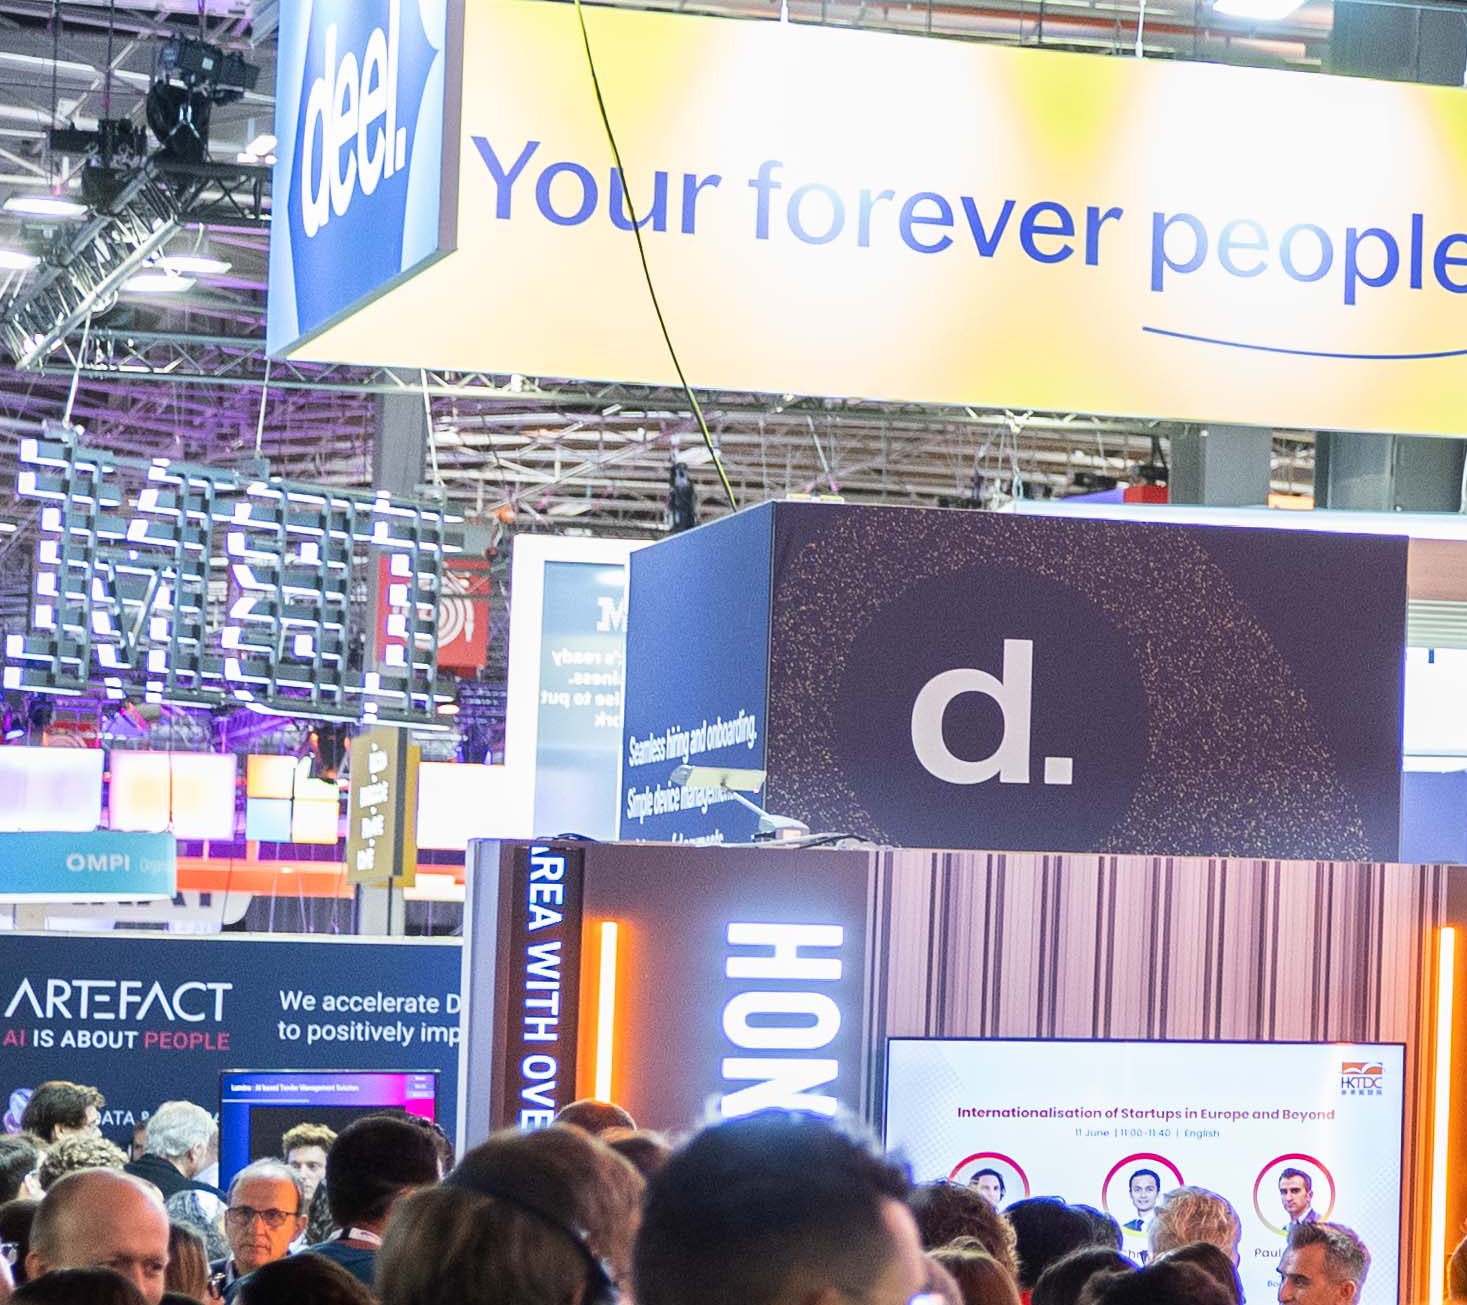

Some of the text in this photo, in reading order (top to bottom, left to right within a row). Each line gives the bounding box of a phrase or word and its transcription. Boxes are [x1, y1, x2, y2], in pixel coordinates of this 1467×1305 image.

[471, 136, 720, 235] Your
[746, 159, 1123, 266] forever
[911, 639, 1073, 785] d.
[629, 709, 757, 766] Seamless hiring and onboarding.
[627, 783, 680, 824] Simple device
[66, 853, 130, 872] OMPI
[4, 977, 233, 1022] ARTEFACT
[280, 990, 440, 1014] We accelerate
[521, 846, 565, 1129] REA WITH OVE
[278, 1020, 415, 1048] to positively
[721, 922, 845, 1117] HON
[3, 1029, 230, 1051] AI IS ABOUT PEOPLE
[1342, 1076, 1382, 1089] HKTDC
[957, 1107, 1336, 1124] Internationalisation of Startups in Europe and Beyond
[1184, 1128, 1220, 1140] English
